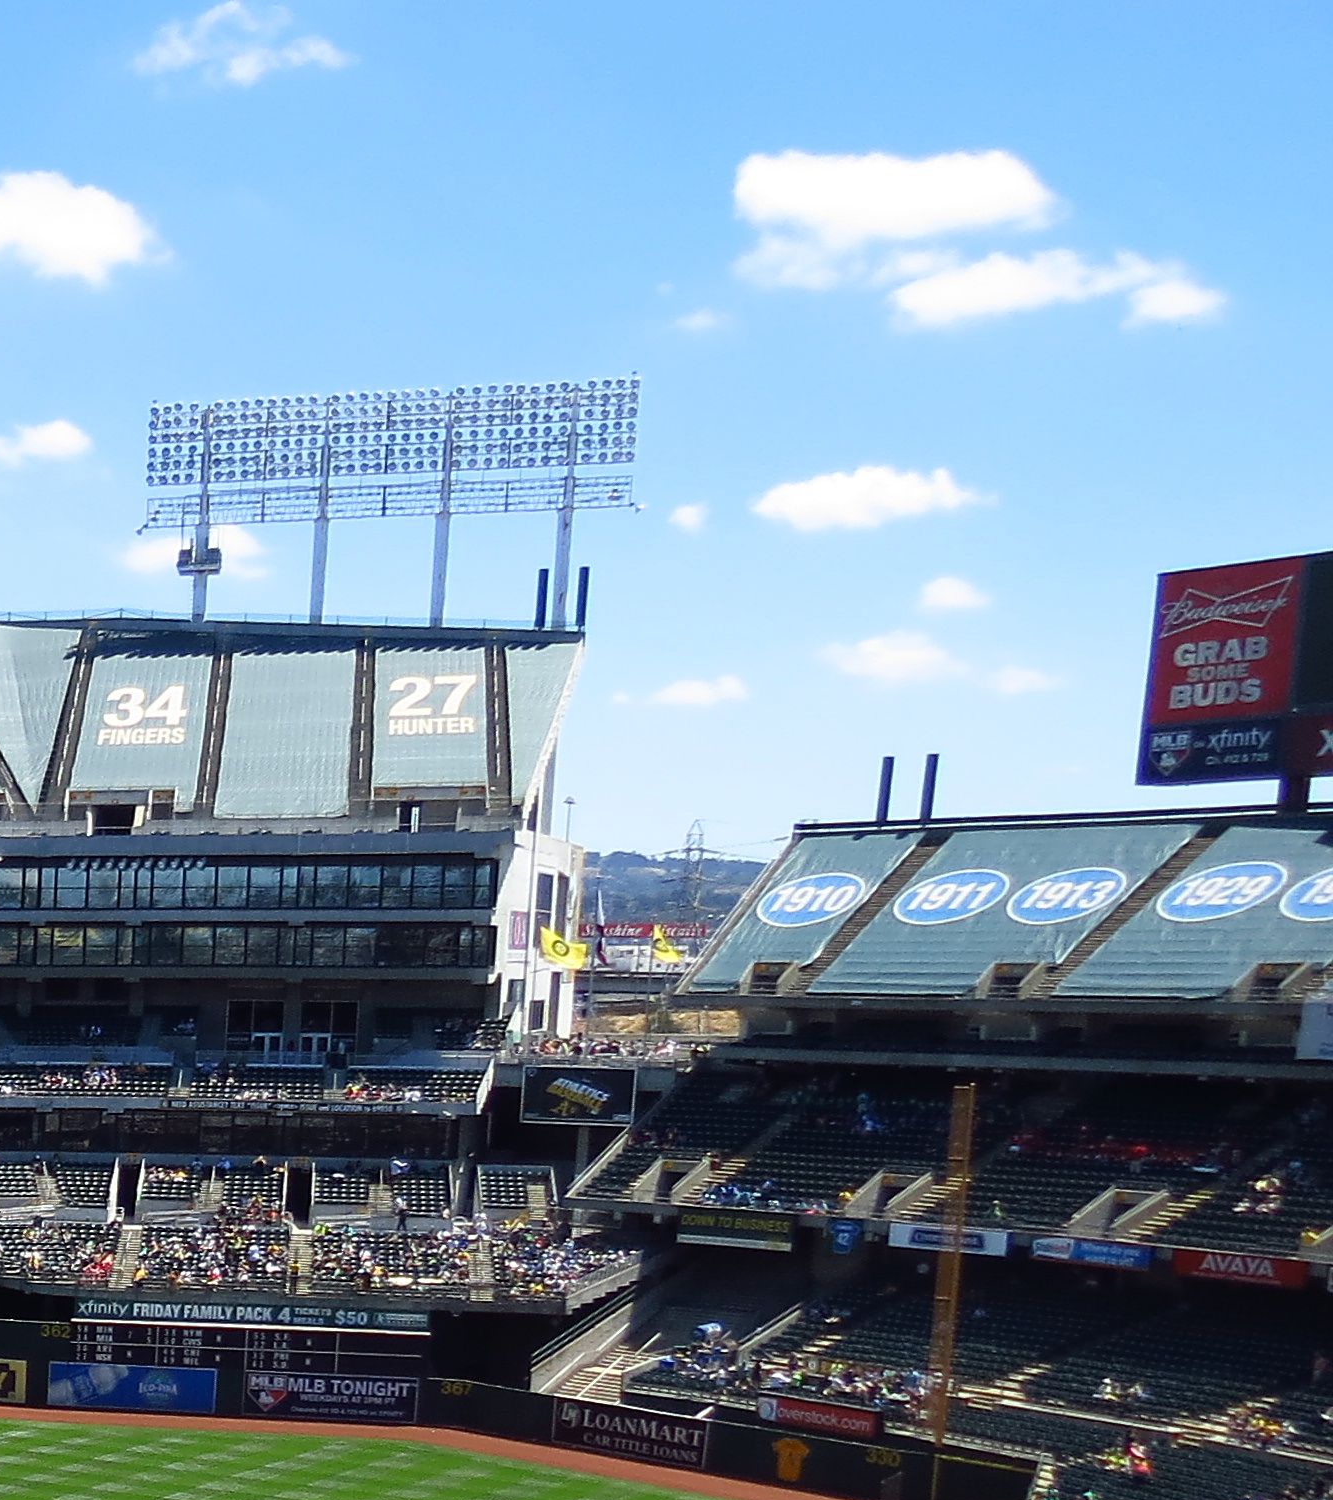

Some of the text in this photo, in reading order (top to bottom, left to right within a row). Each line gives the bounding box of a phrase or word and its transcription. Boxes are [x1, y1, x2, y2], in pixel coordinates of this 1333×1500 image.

[1160, 594, 1288, 625] Budweiser
[1173, 636, 1269, 667] GRAB
[1187, 663, 1250, 683] SOME
[103, 684, 188, 728] 34
[389, 674, 477, 717] 27
[1169, 678, 1262, 709] BUDS
[97, 726, 186, 746] FINGERS
[389, 716, 475, 736] HUNTER
[1208, 727, 1272, 752] xfinity
[770, 883, 858, 912] 1910
[908, 881, 994, 910] 1911
[1022, 880, 1116, 908] 1913
[1172, 876, 1272, 905] 1929
[681, 1213, 790, 1233] DOWN TO BUSINESS
[1199, 1254, 1274, 1277] AVAYA
[78, 1299, 291, 1323] xfinity FRIDAY FAMILY PACK 4
[334, 1308, 368, 1326] $50
[40, 1324, 71, 1339] 362
[250, 1376, 409, 1397] MLB MLB TONIGHT
[299, 1392, 349, 1404] WEEKDAYS
[351, 1394, 362, 1403] AT
[441, 1381, 473, 1396] 367
[777, 1407, 870, 1432] overstock.com
[584, 1432, 698, 1462] CAR TITLE LOANS
